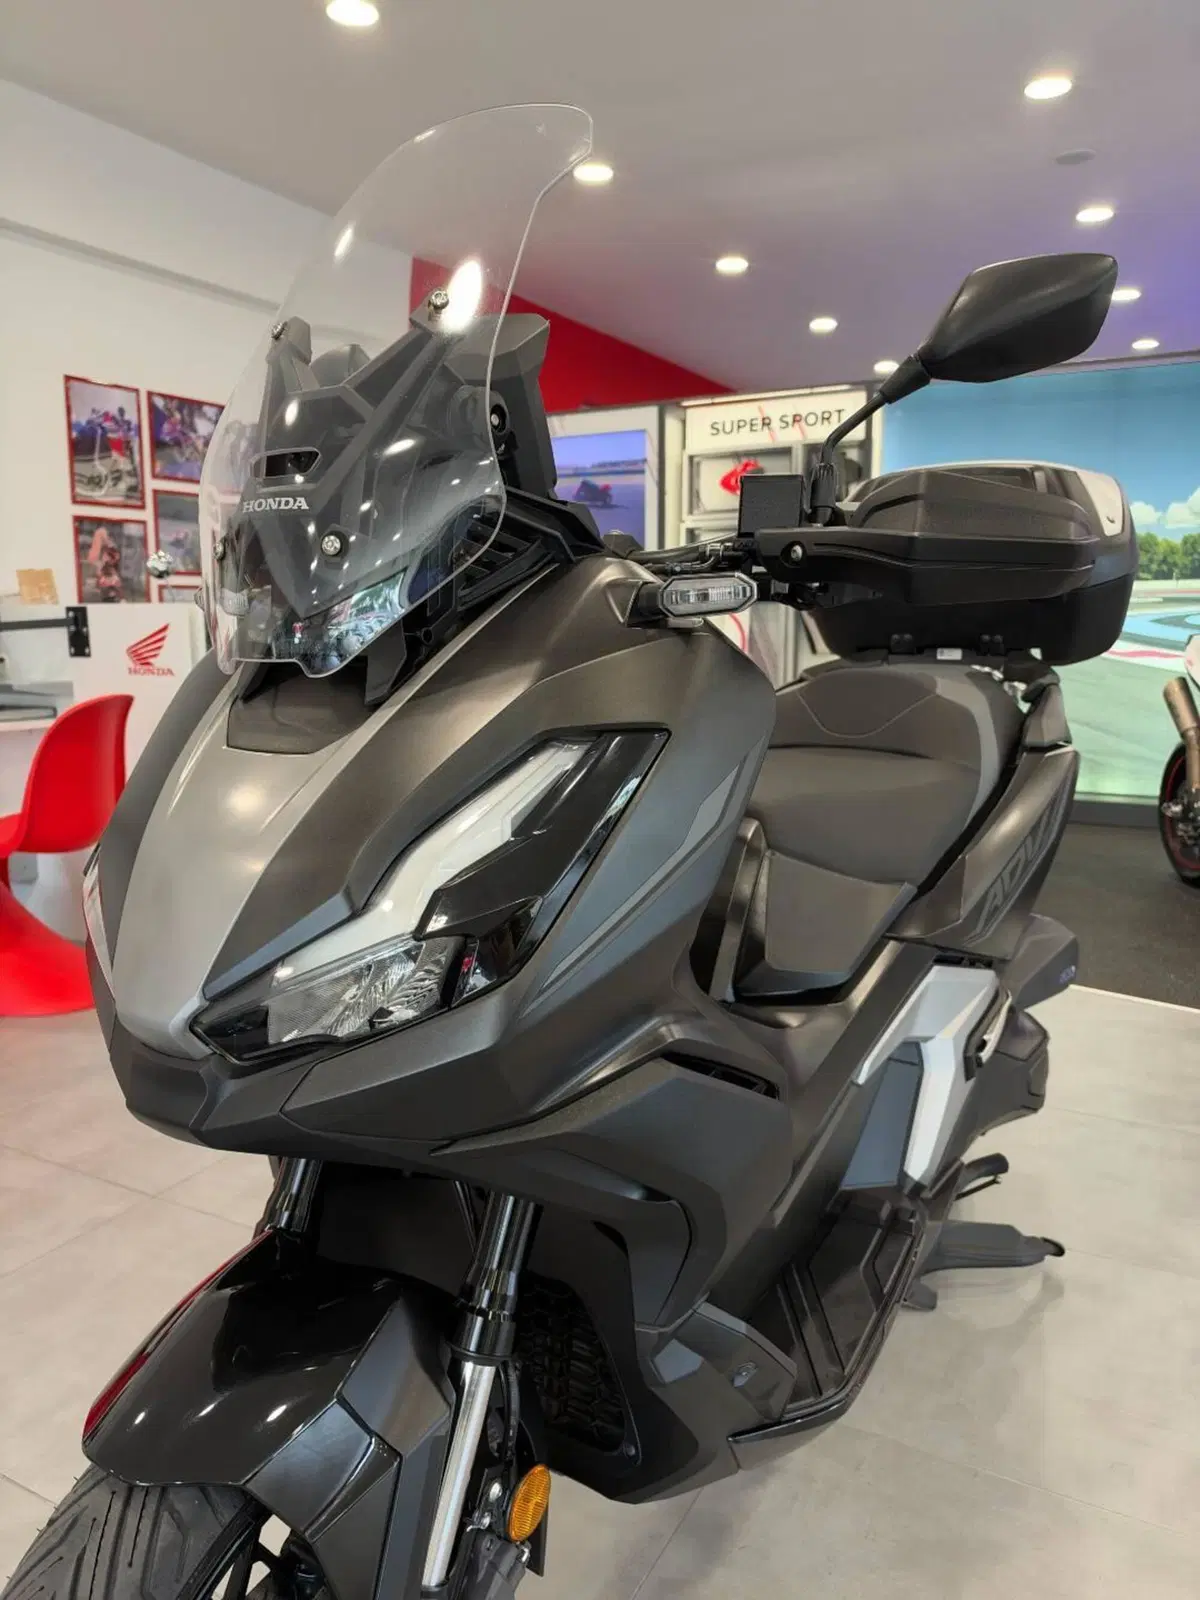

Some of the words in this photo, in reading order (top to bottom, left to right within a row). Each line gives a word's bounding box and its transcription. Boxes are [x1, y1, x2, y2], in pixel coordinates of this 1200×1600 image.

[710, 415, 773, 436] SUPER
[779, 408, 845, 430] SPORT
[242, 497, 309, 513] HONDA
[127, 667, 175, 676] HONDA
